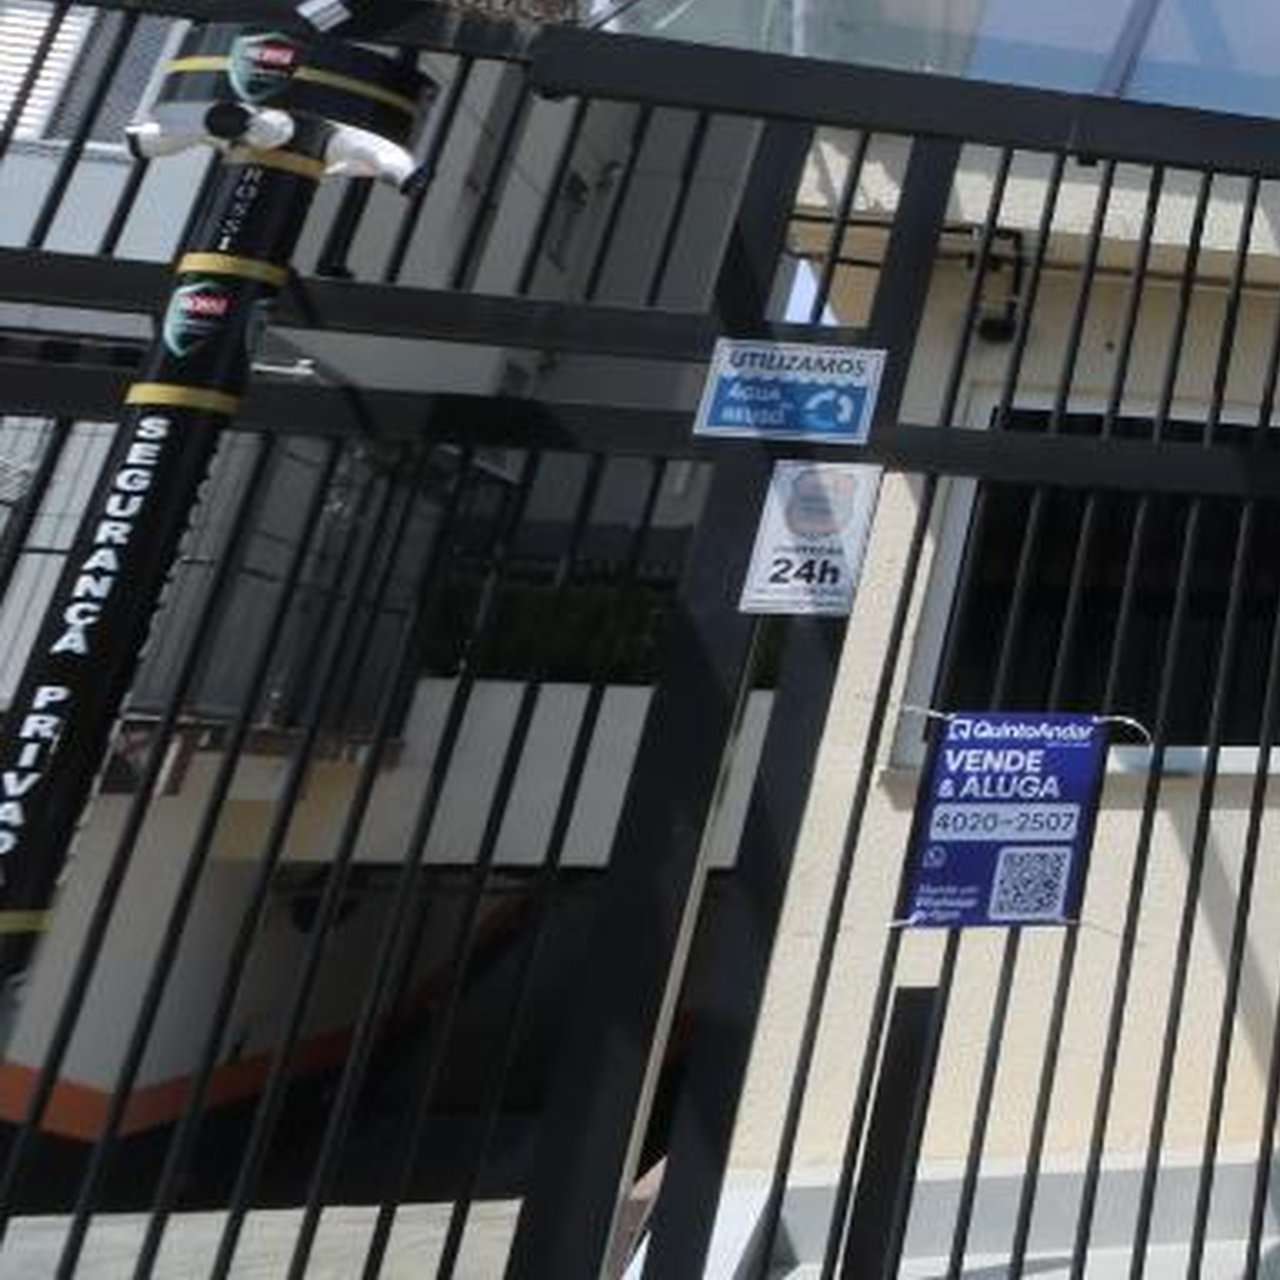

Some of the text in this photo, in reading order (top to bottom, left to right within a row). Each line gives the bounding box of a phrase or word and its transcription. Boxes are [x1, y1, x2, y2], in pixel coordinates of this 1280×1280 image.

[729, 349, 868, 377] UTILIZAMOS
[50, 416, 171, 654] SEGURANÇA
[768, 557, 841, 584] 24h
[973, 719, 1093, 741] QuintoAndar
[945, 749, 1044, 772] VENDE
[937, 776, 1061, 799] & ALUGA
